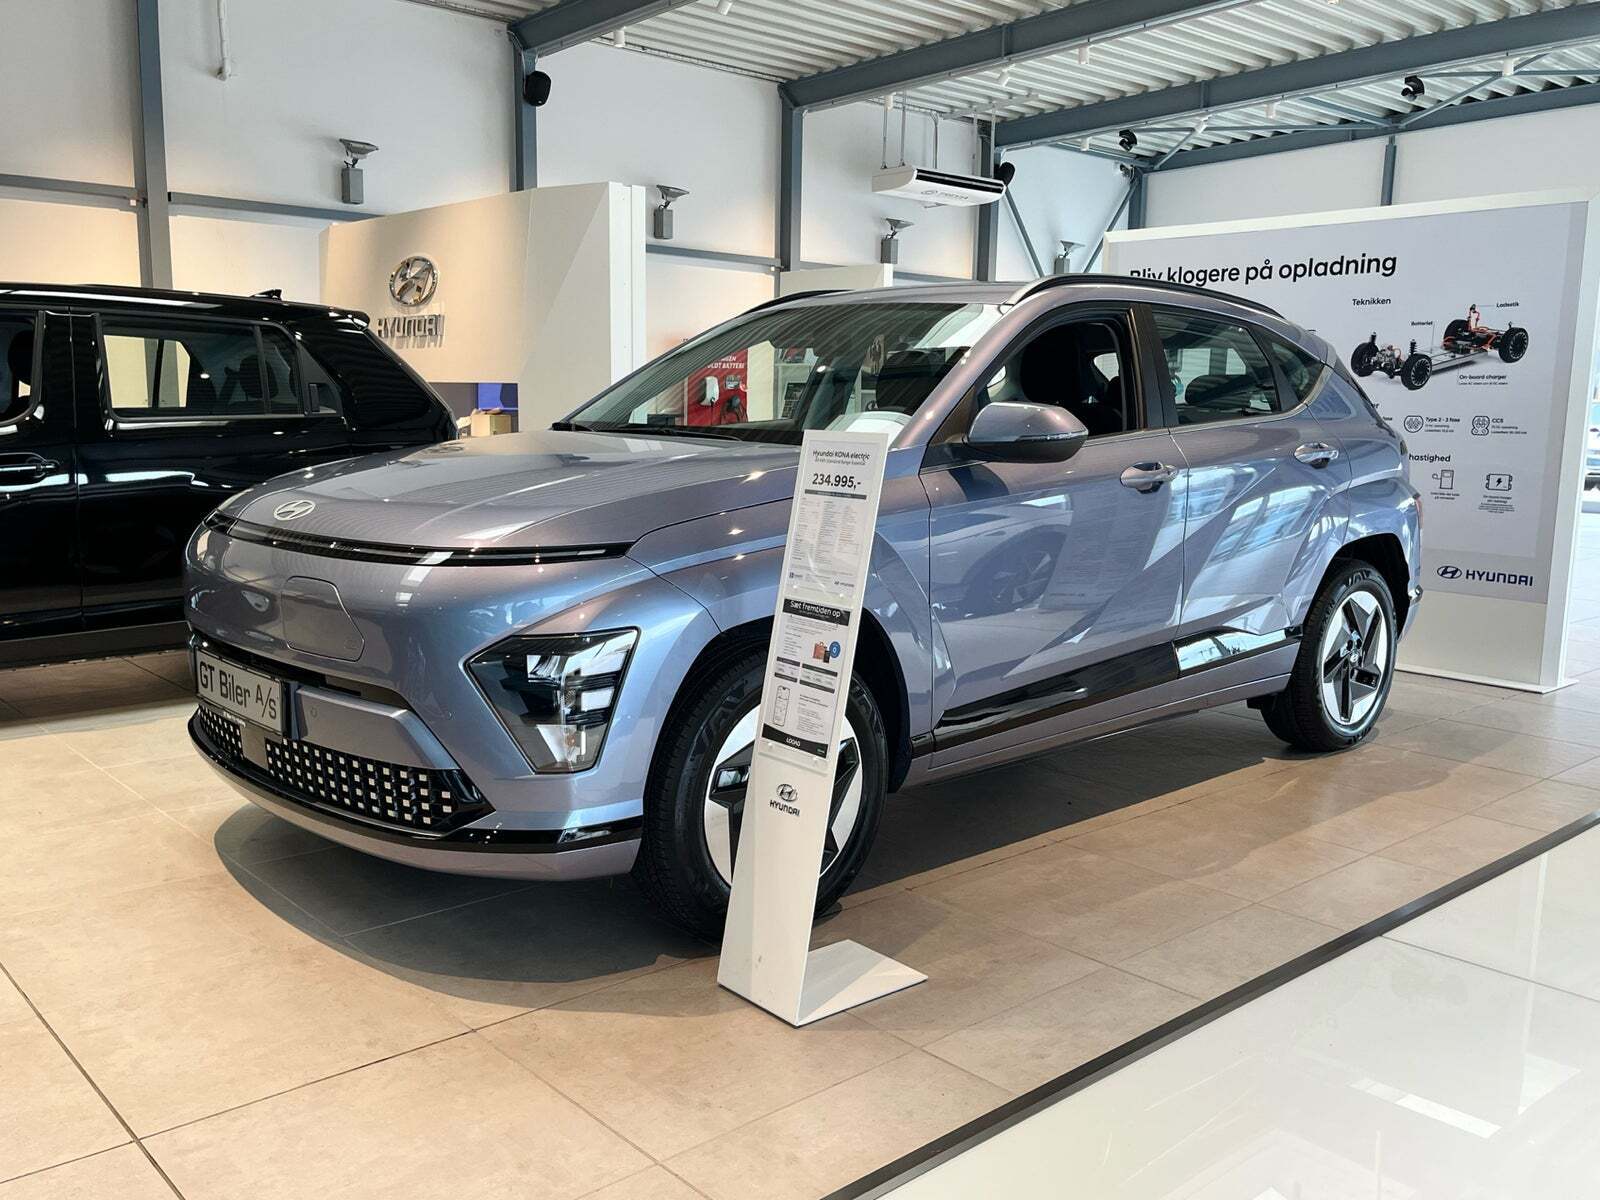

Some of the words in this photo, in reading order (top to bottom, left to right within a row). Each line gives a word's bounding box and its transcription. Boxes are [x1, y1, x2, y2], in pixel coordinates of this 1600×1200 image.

[1167, 266, 1240, 287] klogere
[1245, 259, 1273, 284] på
[1279, 253, 1397, 282] opladning
[1352, 297, 1392, 306] Teknikken
[377, 314, 445, 338] HYUNDAI
[812, 450, 834, 460] Hyundai
[850, 452, 870, 461] electric
[1408, 453, 1451, 463] hastighed
[812, 473, 861, 490] 234.995,-
[1465, 569, 1533, 587] HYUNDAI
[790, 600, 801, 609] Sæt
[801, 601, 831, 616] fremtiden
[832, 609, 841, 619] op
[200, 661, 215, 692] GT
[219, 670, 251, 708] Biler
[769, 799, 801, 816] HYUNDAI
